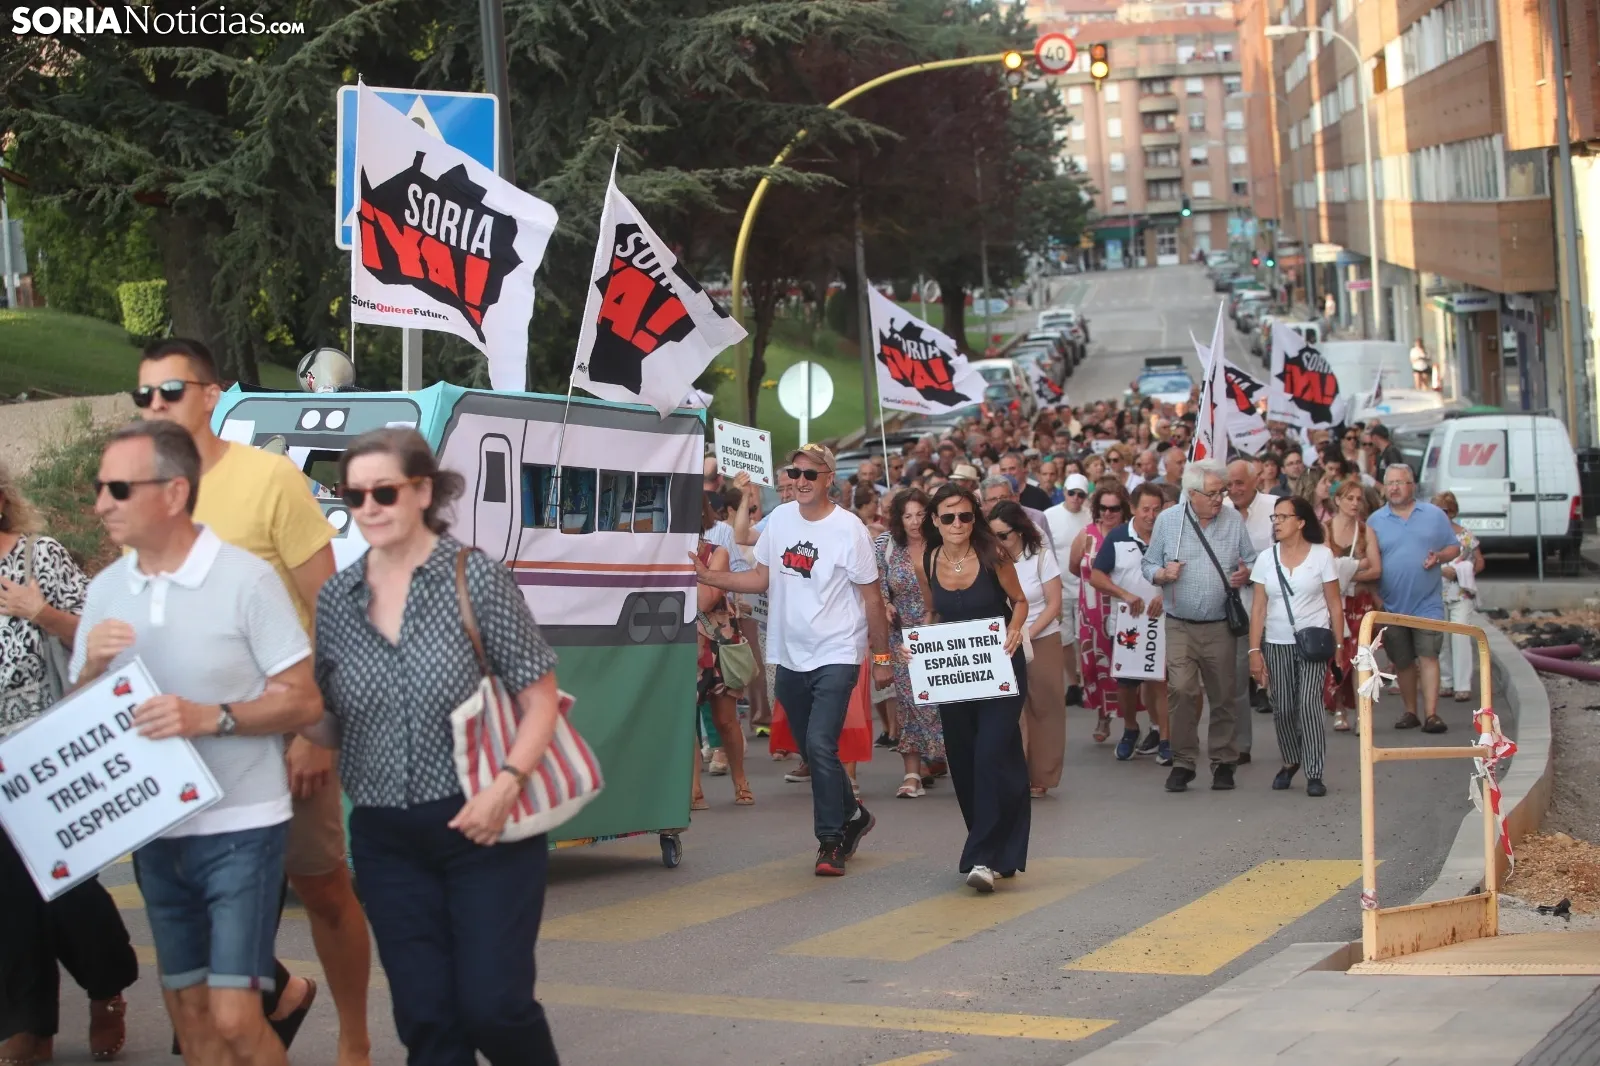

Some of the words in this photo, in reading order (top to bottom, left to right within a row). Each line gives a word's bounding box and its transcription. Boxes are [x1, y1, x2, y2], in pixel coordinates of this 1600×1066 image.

[1046, 45, 1065, 61] 40
[404, 183, 494, 259] SORIA
[361, 198, 490, 326] ¡YA!
[732, 437, 741, 446] NO
[742, 439, 750, 448] ES
[723, 457, 730, 465] ES
[731, 459, 765, 475] DESPRECIO
[796, 545, 815, 558] SORIA
[909, 642, 944, 655] SORIA
[947, 638, 966, 651] SIN
[968, 634, 1002, 649] TREN.
[924, 653, 970, 671] ESPAÑA
[972, 652, 992, 665] SIN
[927, 669, 995, 687] VERGÜENZA
[1, 774, 31, 803] NO
[30, 757, 58, 784] ES
[57, 722, 116, 768] FALTA
[47, 771, 108, 814] TREN,
[103, 753, 132, 780] ES
[56, 776, 161, 850] DESPRECIO
